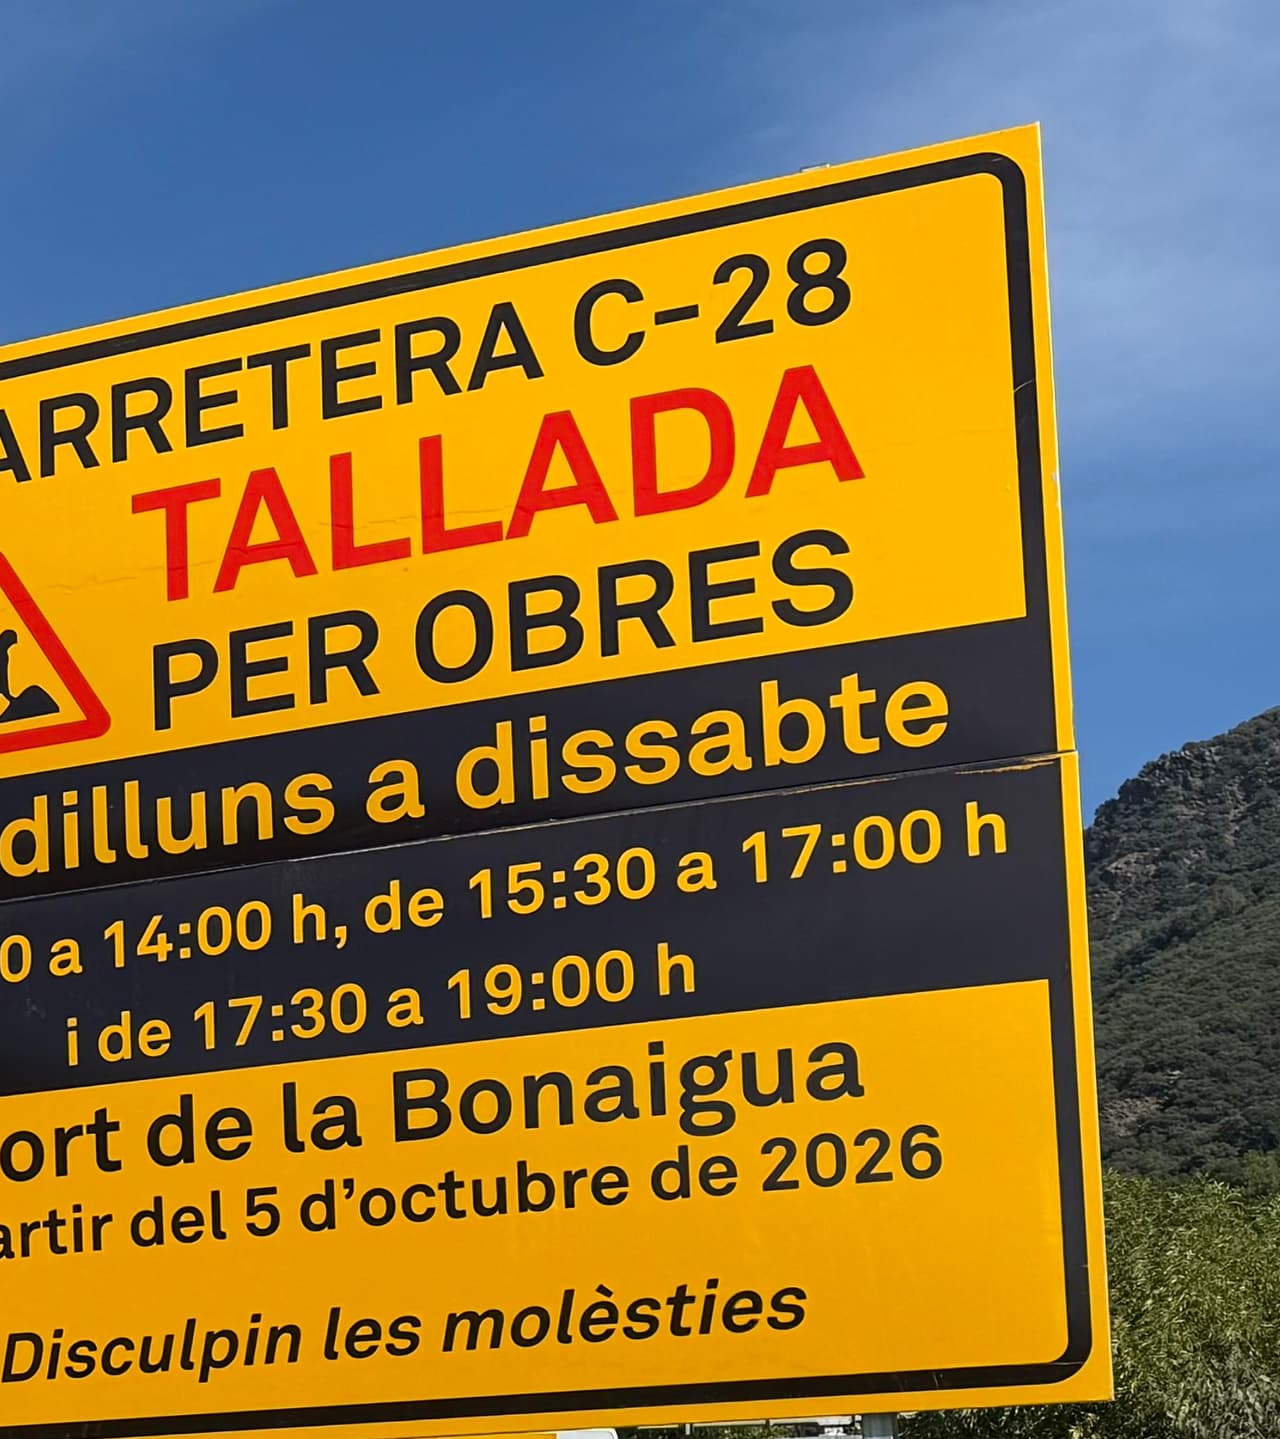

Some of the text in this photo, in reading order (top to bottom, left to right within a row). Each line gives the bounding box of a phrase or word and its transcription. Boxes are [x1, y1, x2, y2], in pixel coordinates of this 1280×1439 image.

[575, 239, 850, 365] C-28
[133, 364, 865, 601] TALLADA
[154, 530, 853, 730] PER OBRES
[0, 773, 334, 876] dilluns
[367, 760, 425, 823] a
[456, 674, 948, 809] dissabte
[50, 939, 82, 976] a
[105, 901, 271, 967] 14:00
[293, 895, 346, 947] h,
[365, 880, 443, 933] de
[470, 848, 655, 918] 15:30
[677, 852, 717, 892] a
[743, 810, 941, 882] 17:00
[966, 802, 1006, 856] h
[68, 944, 694, 1065] i de 17:30 a 19:00 h
[148, 1094, 252, 1166] de
[283, 1082, 362, 1152] la
[393, 1042, 864, 1142] Bonaigua
[2, 1125, 941, 1382] 2026 Disculpin les
[131, 1191, 226, 1246] del
[247, 1187, 280, 1236] 5
[301, 1161, 628, 1231] d'octubre
[652, 1146, 737, 1200] de
[443, 1279, 806, 1351] molèsties
